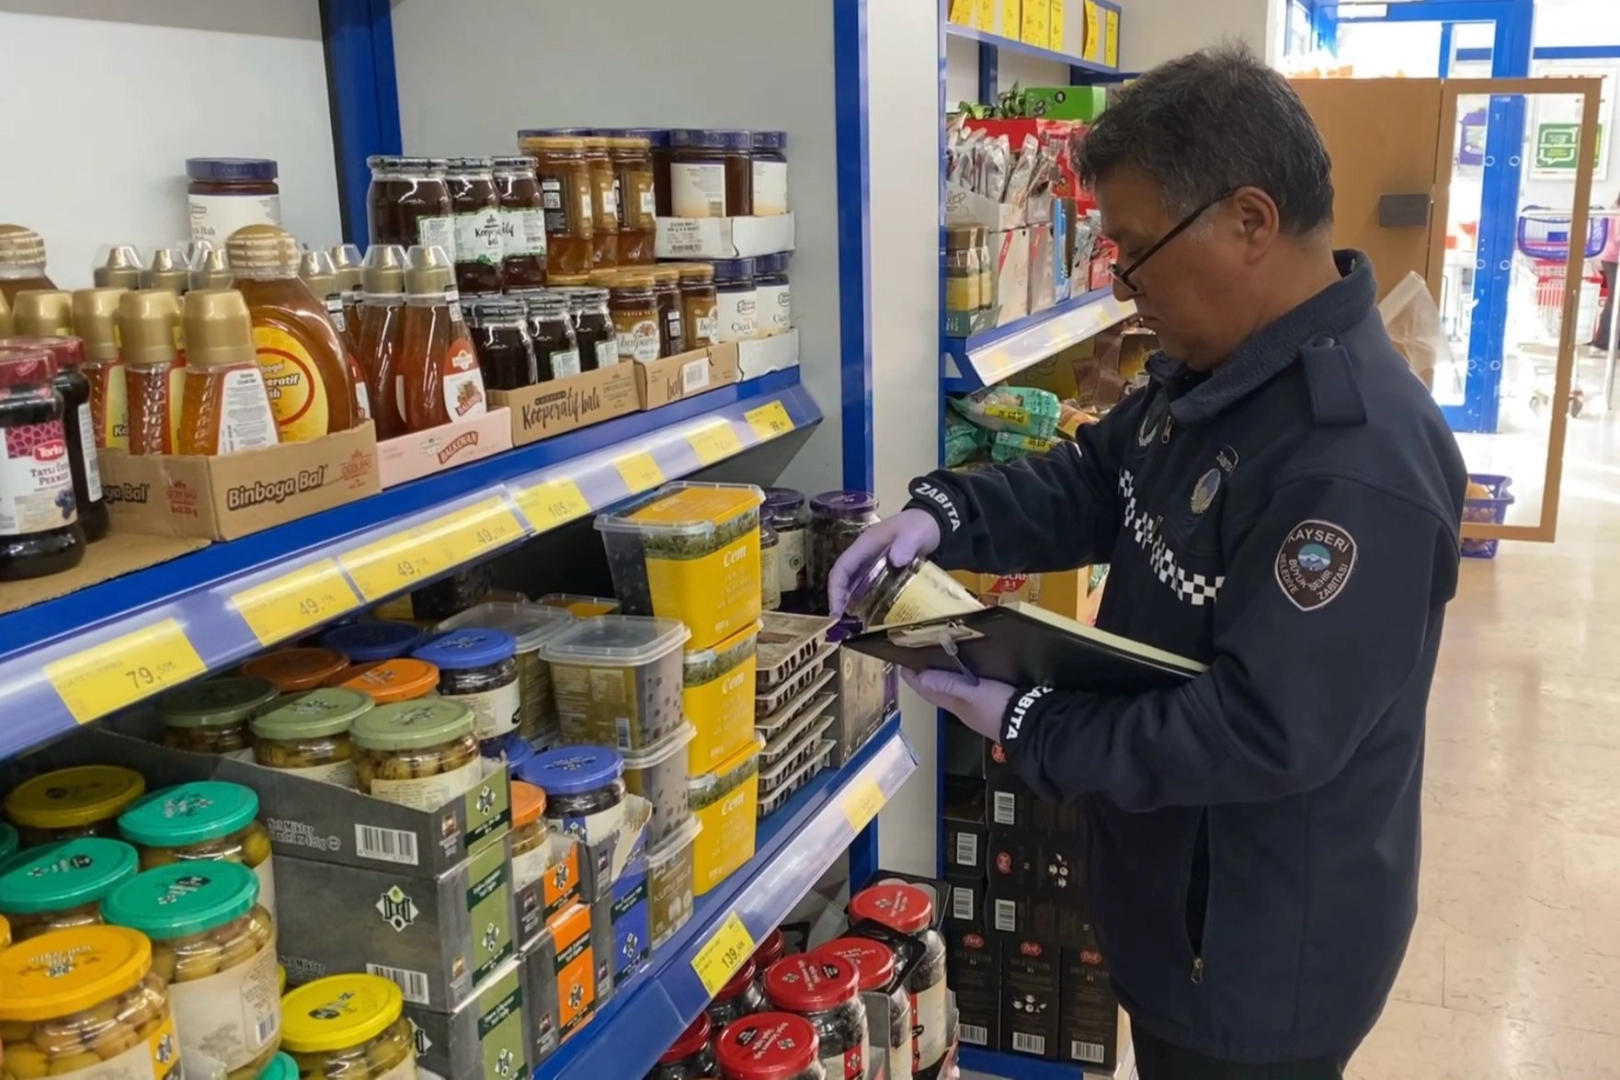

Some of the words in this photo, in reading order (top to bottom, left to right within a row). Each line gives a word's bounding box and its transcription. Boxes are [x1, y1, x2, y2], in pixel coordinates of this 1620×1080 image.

[522, 386, 580, 430] Kooperatif
[298, 464, 325, 493] Bal
[915, 482, 961, 532] ZABITA
[723, 545, 748, 568] Cem
[1316, 563, 1349, 600] ZABITASI
[721, 671, 745, 695] Cem
[1006, 686, 1053, 739] ZABITA
[721, 793, 745, 816] Cem
